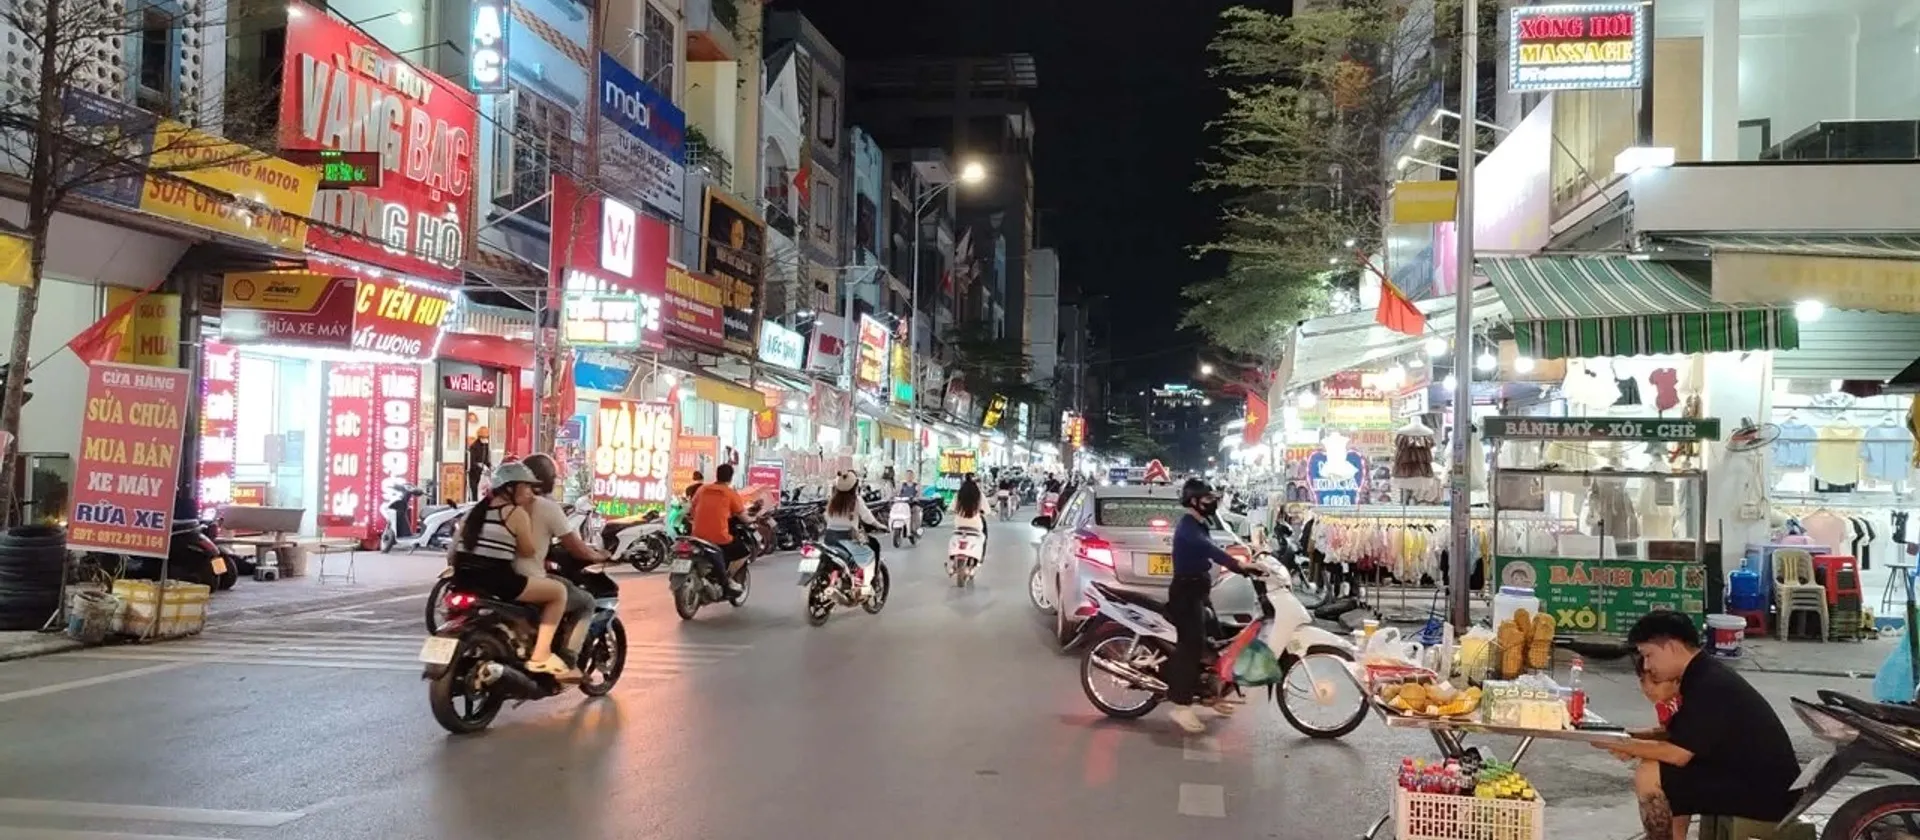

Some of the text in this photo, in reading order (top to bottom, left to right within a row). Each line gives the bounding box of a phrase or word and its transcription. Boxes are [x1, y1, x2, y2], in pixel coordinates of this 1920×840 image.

[1519, 14, 1584, 38] XÔNG
[1520, 41, 1633, 65] MASSAGE
[301, 53, 404, 172] VÀNG
[406, 106, 470, 202] BẠC
[254, 163, 301, 194] MOTOR
[416, 203, 463, 269] HỒ
[376, 284, 416, 322] YẾN
[412, 294, 450, 328] HUY
[259, 316, 348, 337] CHỮA XE MÁY
[134, 371, 175, 391] HÀNG
[449, 373, 496, 395] wallace
[87, 388, 180, 430] SỬA CHỮA
[599, 401, 673, 450] VÀNG
[1504, 419, 1559, 436] BÁNH
[1608, 420, 1643, 437] XÔI
[1656, 420, 1697, 438] CHÈ
[84, 436, 175, 468] MUA BÁN
[87, 471, 163, 498] XE MÁY
[131, 508, 167, 530] XE
[1550, 562, 1678, 589] BÁNH MÌ
[1556, 606, 1608, 630] XÔI
